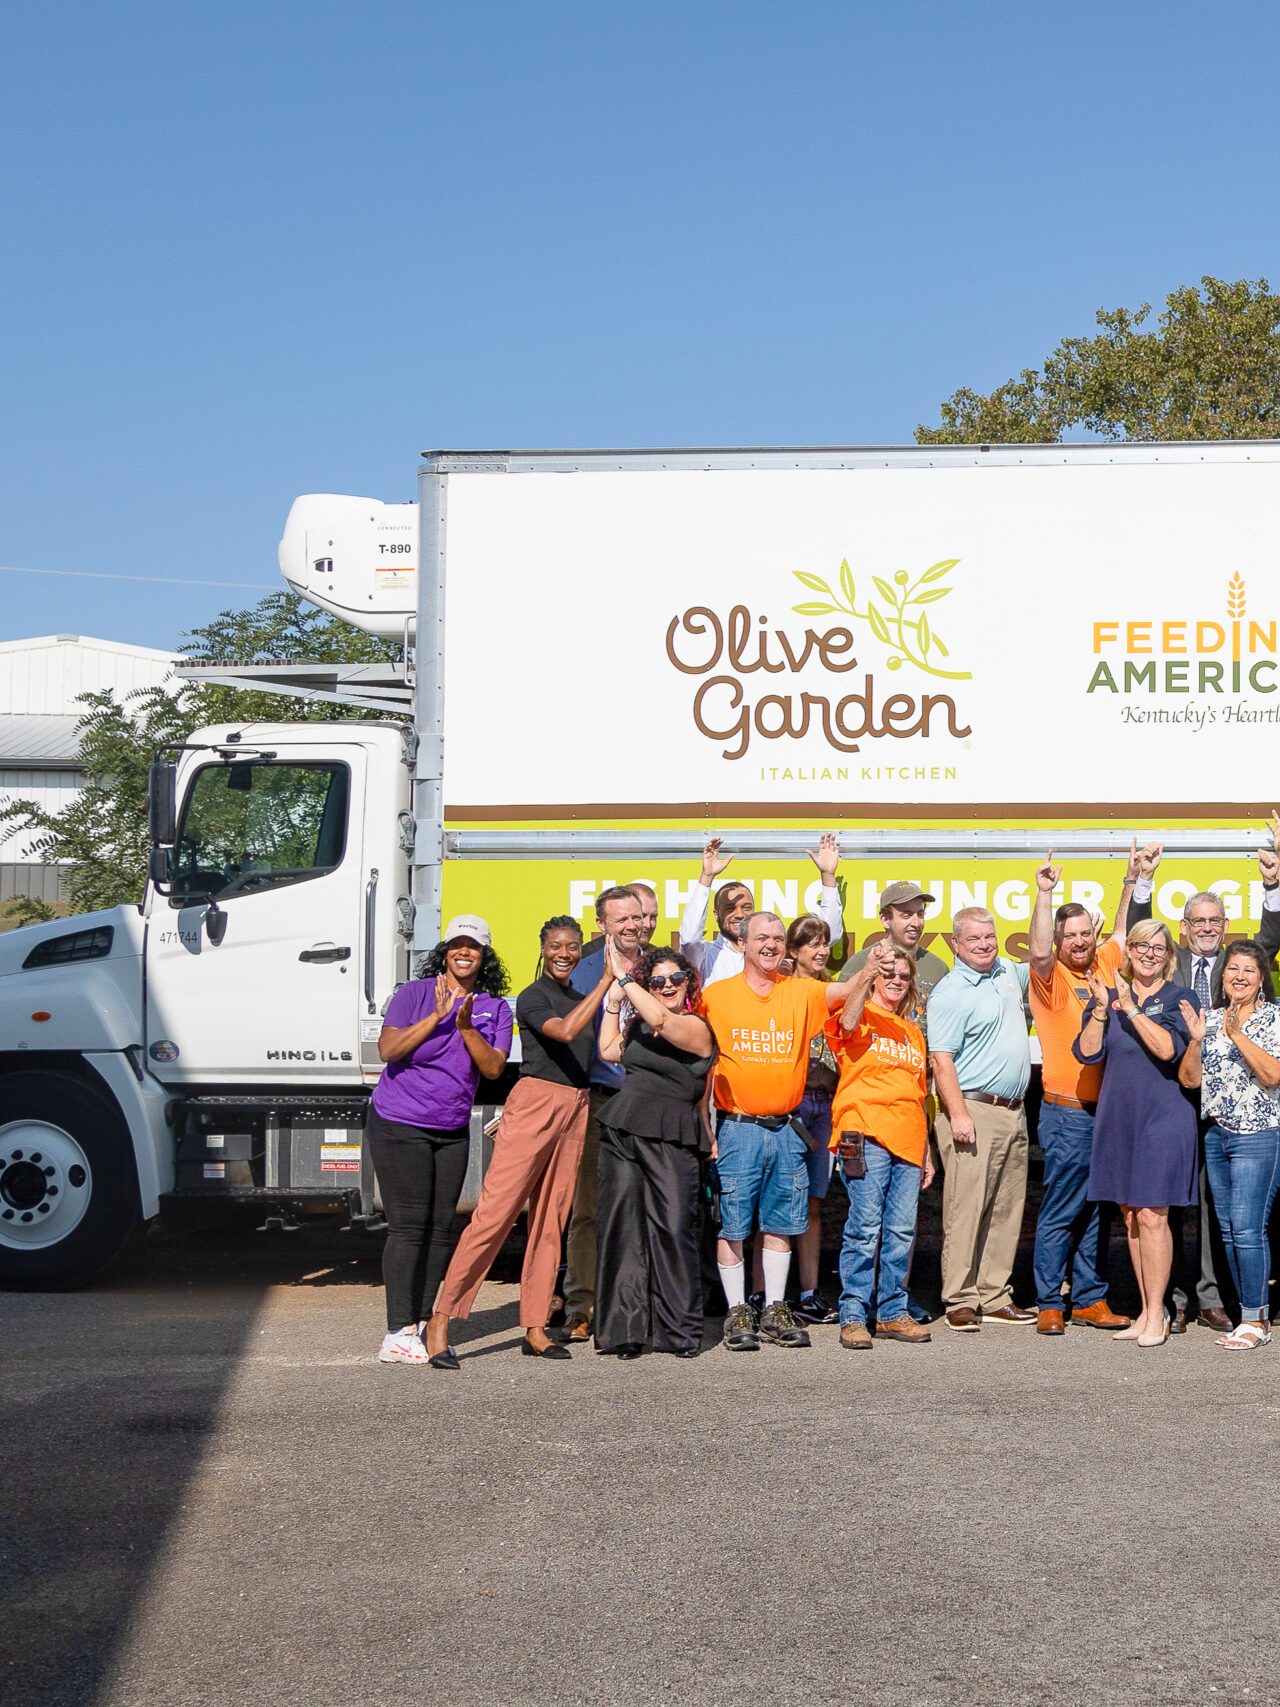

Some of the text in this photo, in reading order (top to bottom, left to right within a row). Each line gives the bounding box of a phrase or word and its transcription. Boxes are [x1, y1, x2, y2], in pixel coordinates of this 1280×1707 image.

[378, 544, 411, 553] T-890
[665, 604, 858, 674] Olive
[693, 674, 972, 760] Garden
[1121, 700, 1217, 733] Kentucky's
[761, 766, 957, 780] ITALIAN KITCHEN
[160, 931, 198, 943] 471744
[731, 1028, 794, 1042] FEEDING
[267, 1050, 316, 1061] HINO
[868, 1043, 925, 1072] AMERICA
